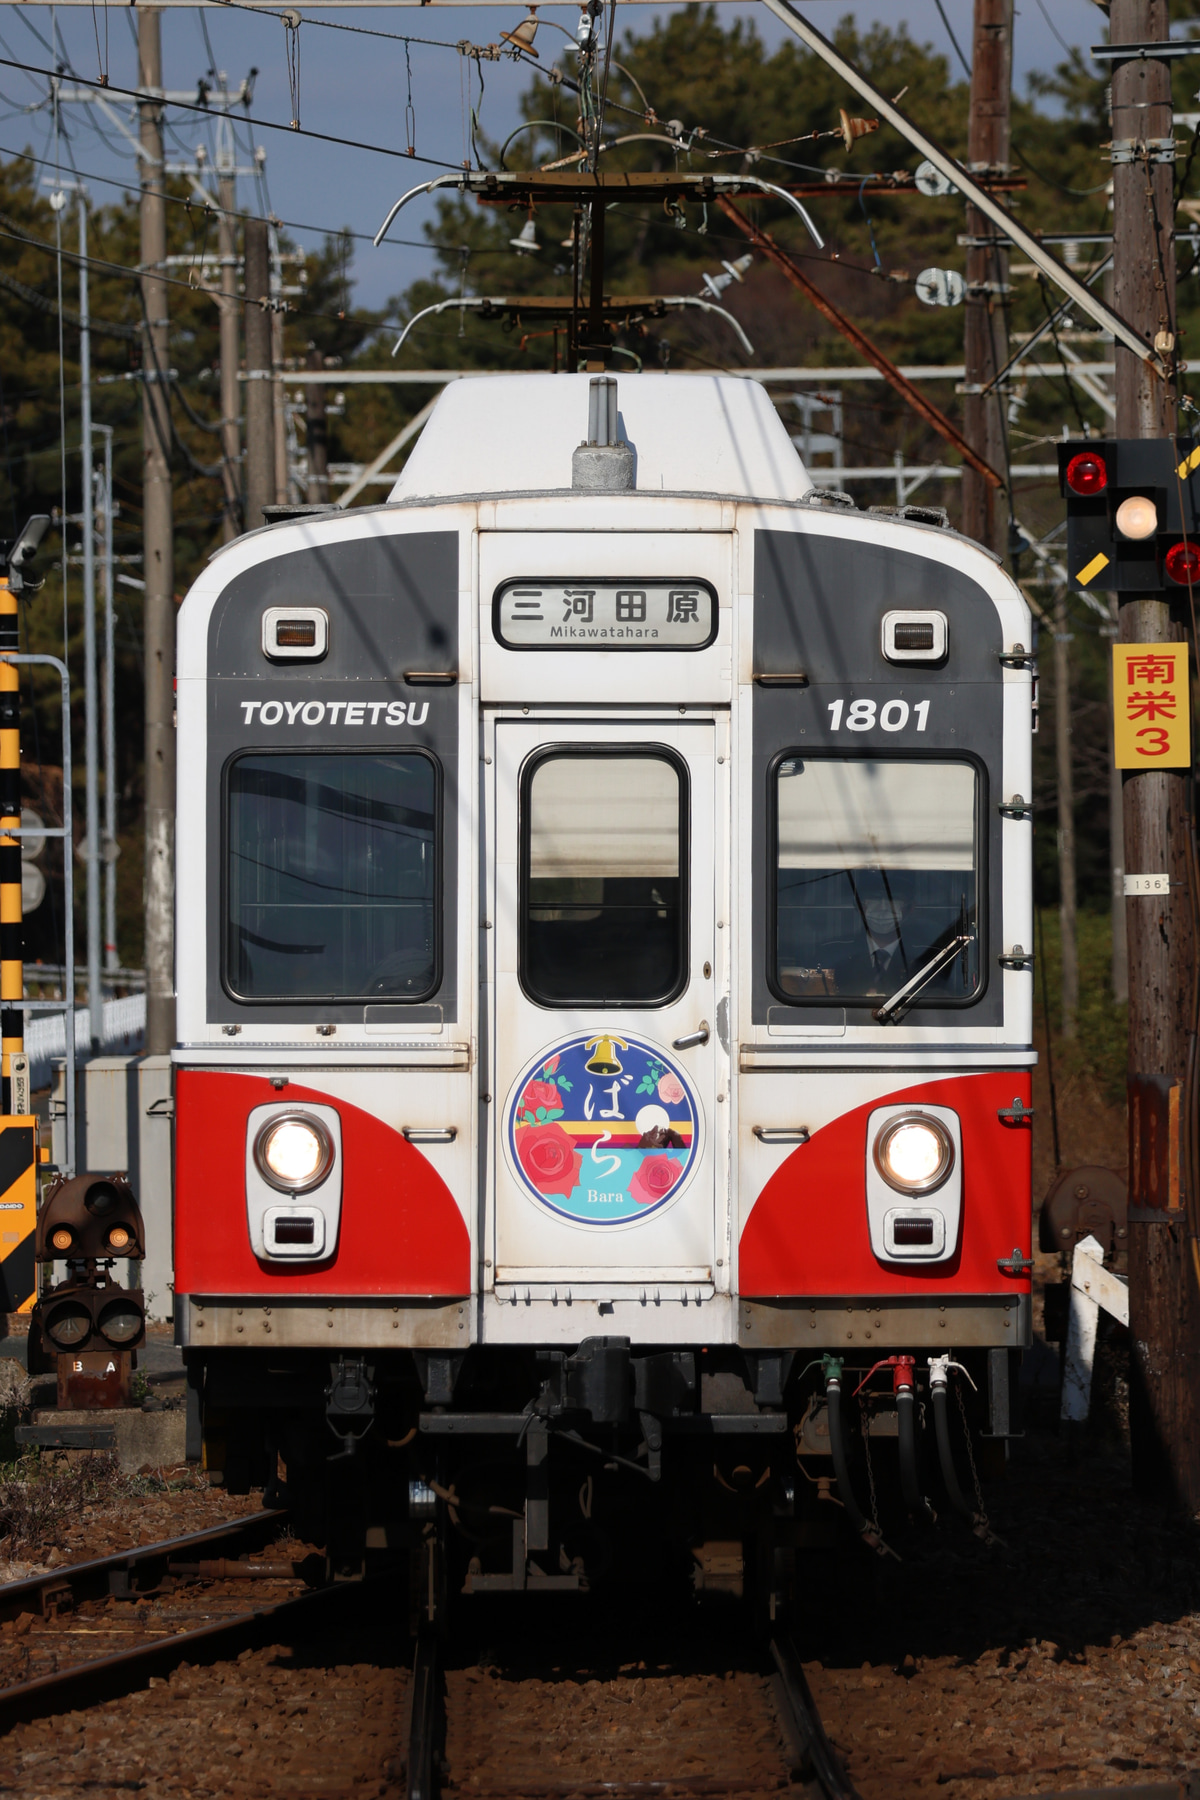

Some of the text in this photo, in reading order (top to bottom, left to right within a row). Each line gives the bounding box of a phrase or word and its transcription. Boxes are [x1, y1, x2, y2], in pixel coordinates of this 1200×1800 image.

[511, 589, 700, 623] 三河田原
[550, 626, 659, 638] Mikawatahara
[240, 701, 430, 725] TOYOTETSU
[827, 699, 931, 732] 1801
[584, 1075, 634, 1180] ばら
[587, 1190, 624, 1203] Bara
[73, 1361, 116, 1372] B A
